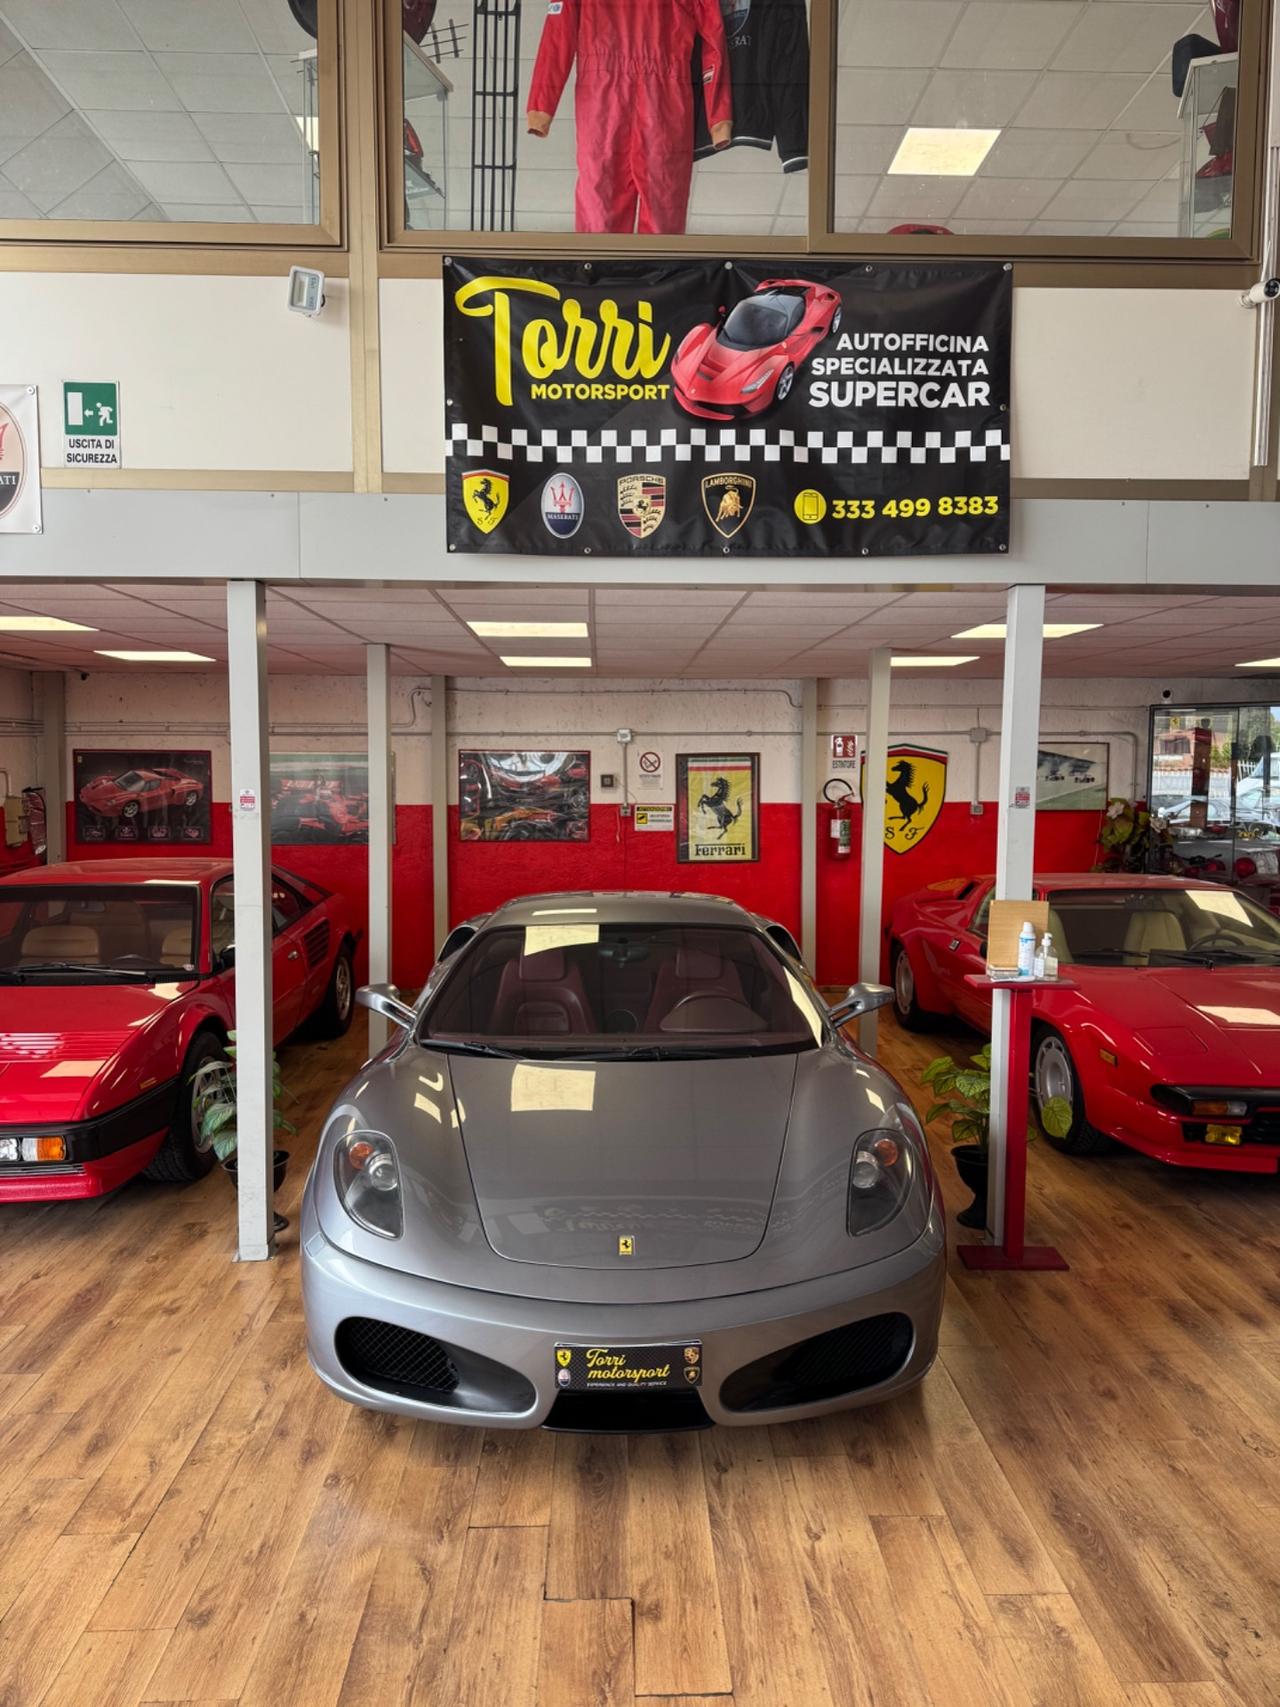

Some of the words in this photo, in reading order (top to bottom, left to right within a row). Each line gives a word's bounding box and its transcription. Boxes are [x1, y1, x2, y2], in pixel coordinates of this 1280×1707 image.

[454, 275, 671, 406] Torri
[836, 333, 990, 353] AUTOFFICINA
[811, 357, 989, 376] SPECIALIZZATA
[530, 383, 671, 400] MOTORSPORT
[808, 380, 991, 409] SUPERCAR
[68, 439, 102, 449] USCITA
[105, 439, 115, 449] DI
[66, 452, 117, 463] SICUREZZA
[704, 475, 753, 488] LAMBORGHINI
[547, 512, 579, 520] MASERATI
[832, 499, 875, 519] 333
[882, 498, 931, 518] 499
[937, 496, 999, 516] 8383
[694, 843, 746, 856] Ferrari
[586, 1348, 626, 1368] Torri
[587, 1364, 671, 1383] motorsport
